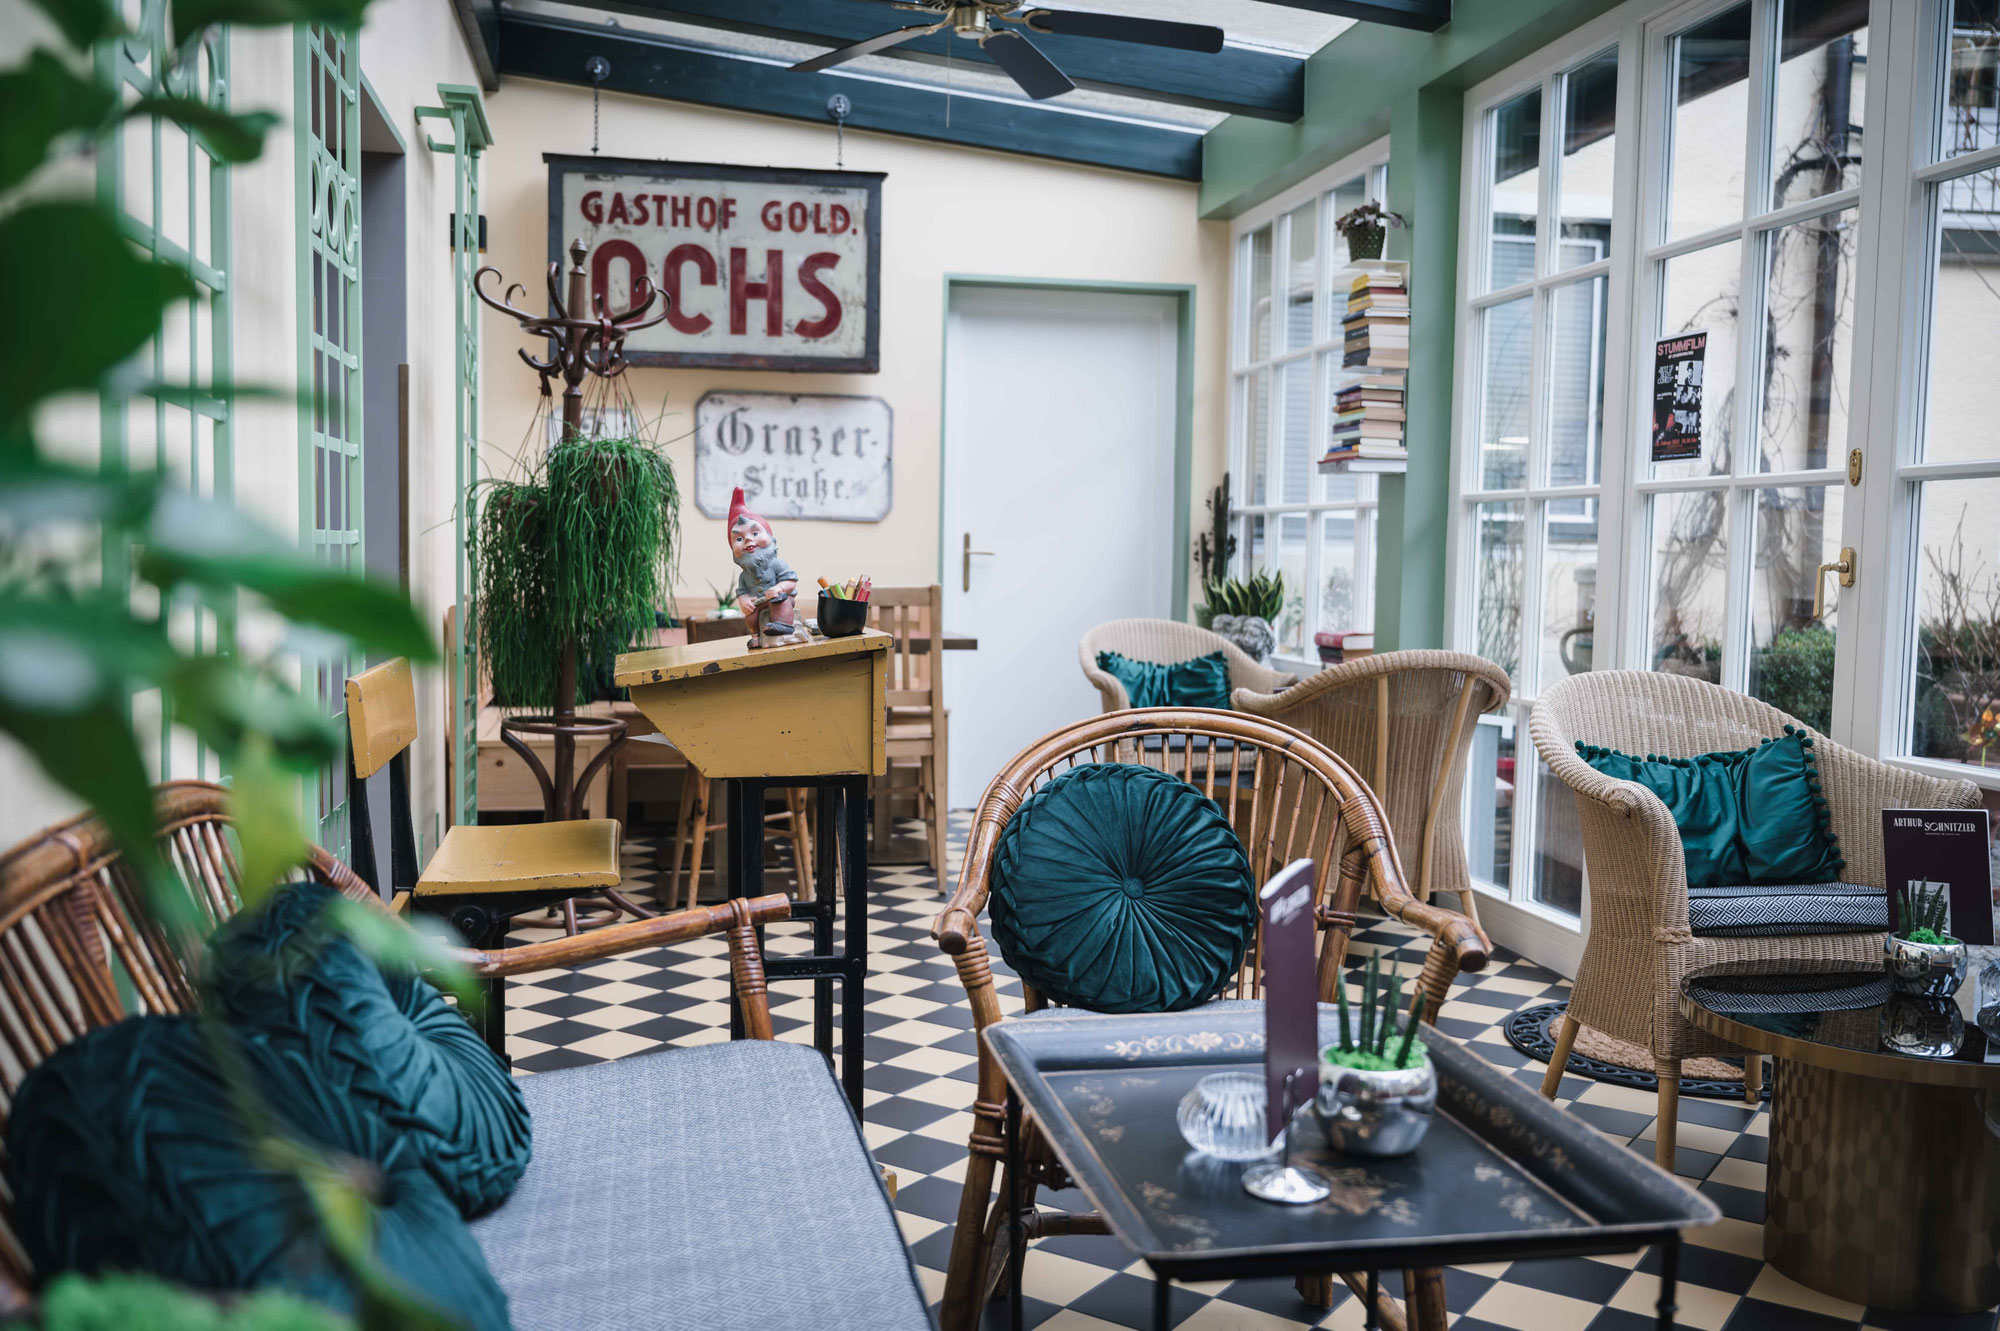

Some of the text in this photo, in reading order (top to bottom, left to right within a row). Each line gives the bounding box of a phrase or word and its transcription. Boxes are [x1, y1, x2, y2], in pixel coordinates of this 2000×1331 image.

[580, 190, 857, 235] GASTHOF GOLD.
[591, 239, 843, 338] OCHS
[1657, 335, 1706, 356] STUMMFILM
[716, 407, 878, 463] Grazer-
[1894, 817, 1976, 832] ARTHUR SCHNITZLER
